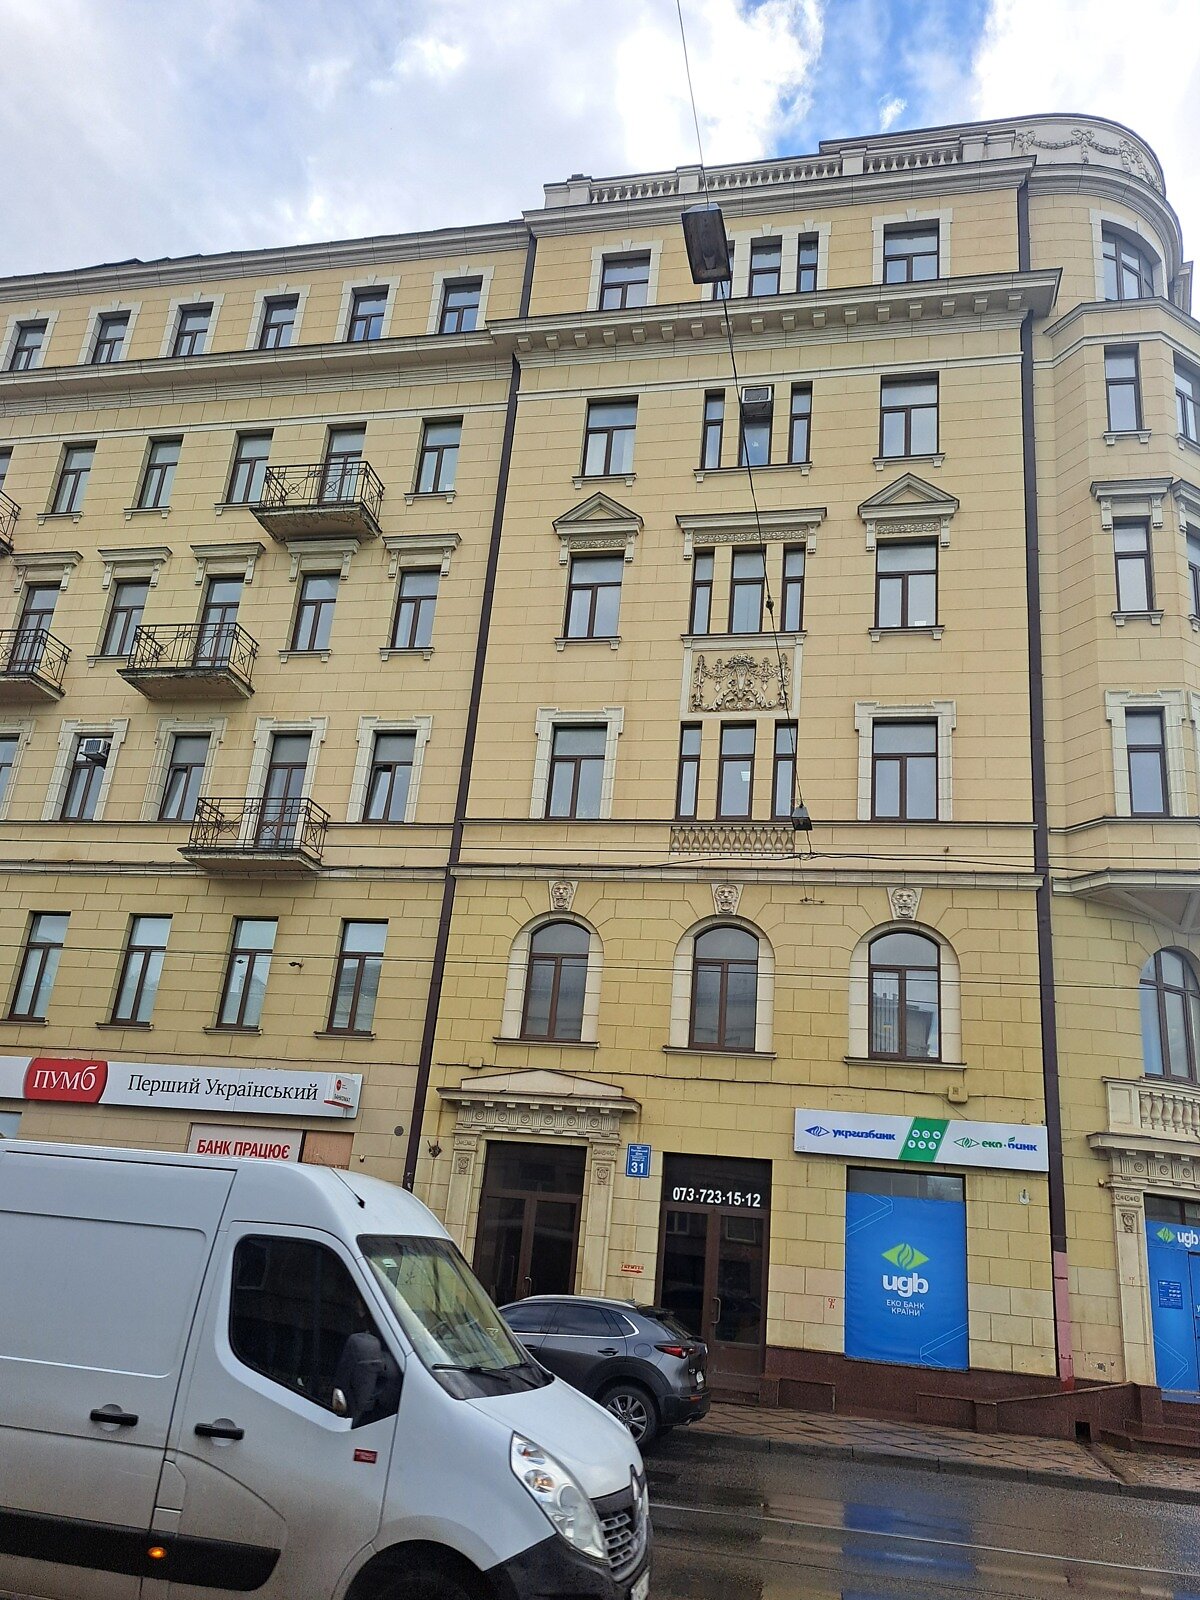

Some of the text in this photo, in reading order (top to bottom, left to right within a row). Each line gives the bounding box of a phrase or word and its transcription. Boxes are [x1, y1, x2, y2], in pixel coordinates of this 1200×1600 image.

[127, 1074, 201, 1096] Перший
[204, 1078, 319, 1101] Український
[197, 1139, 290, 1160] БАНК ПРАЦЮЄ
[631, 1161, 645, 1174] 31
[1177, 1230, 1199, 1248] ugb
[882, 1272, 930, 1298] ugb
[886, 1299, 925, 1310] ЕКО БАНК
[891, 1307, 921, 1317] КРАЇНИ
